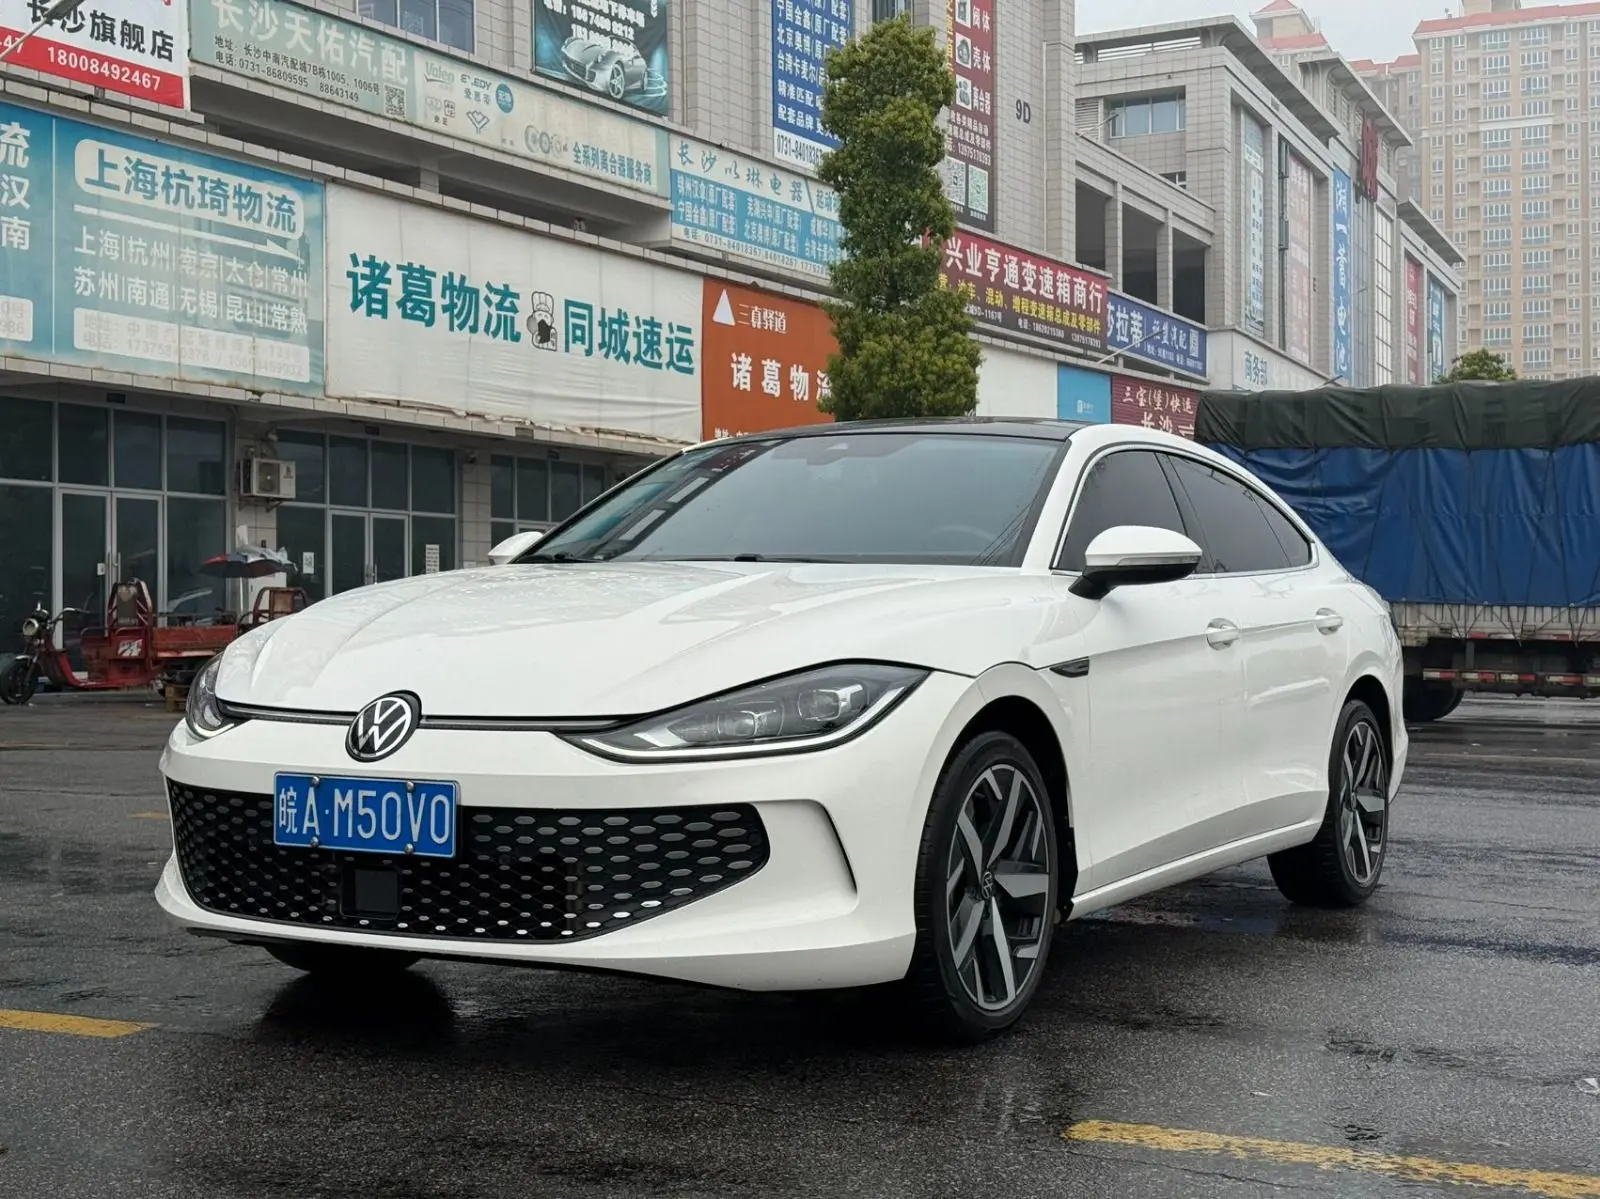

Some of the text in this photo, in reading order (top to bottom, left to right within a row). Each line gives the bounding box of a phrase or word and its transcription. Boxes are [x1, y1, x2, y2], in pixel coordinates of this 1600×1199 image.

[211, 0, 409, 85] 长沙天佑汽配
[972, 45, 991, 74] 壳体
[48, 46, 161, 92] 18008492467
[319, 81, 359, 102] 88643149
[777, 78, 814, 108] 精准匹配
[777, 103, 814, 131] 配套品牌
[1016, 98, 1031, 124] 9D
[84, 148, 297, 233] 上海杭琦物流
[1, 215, 31, 251] 南
[945, 236, 1102, 315] 兴业亨通变速箱商行
[346, 252, 695, 375] 诸葛物流 同城速运
